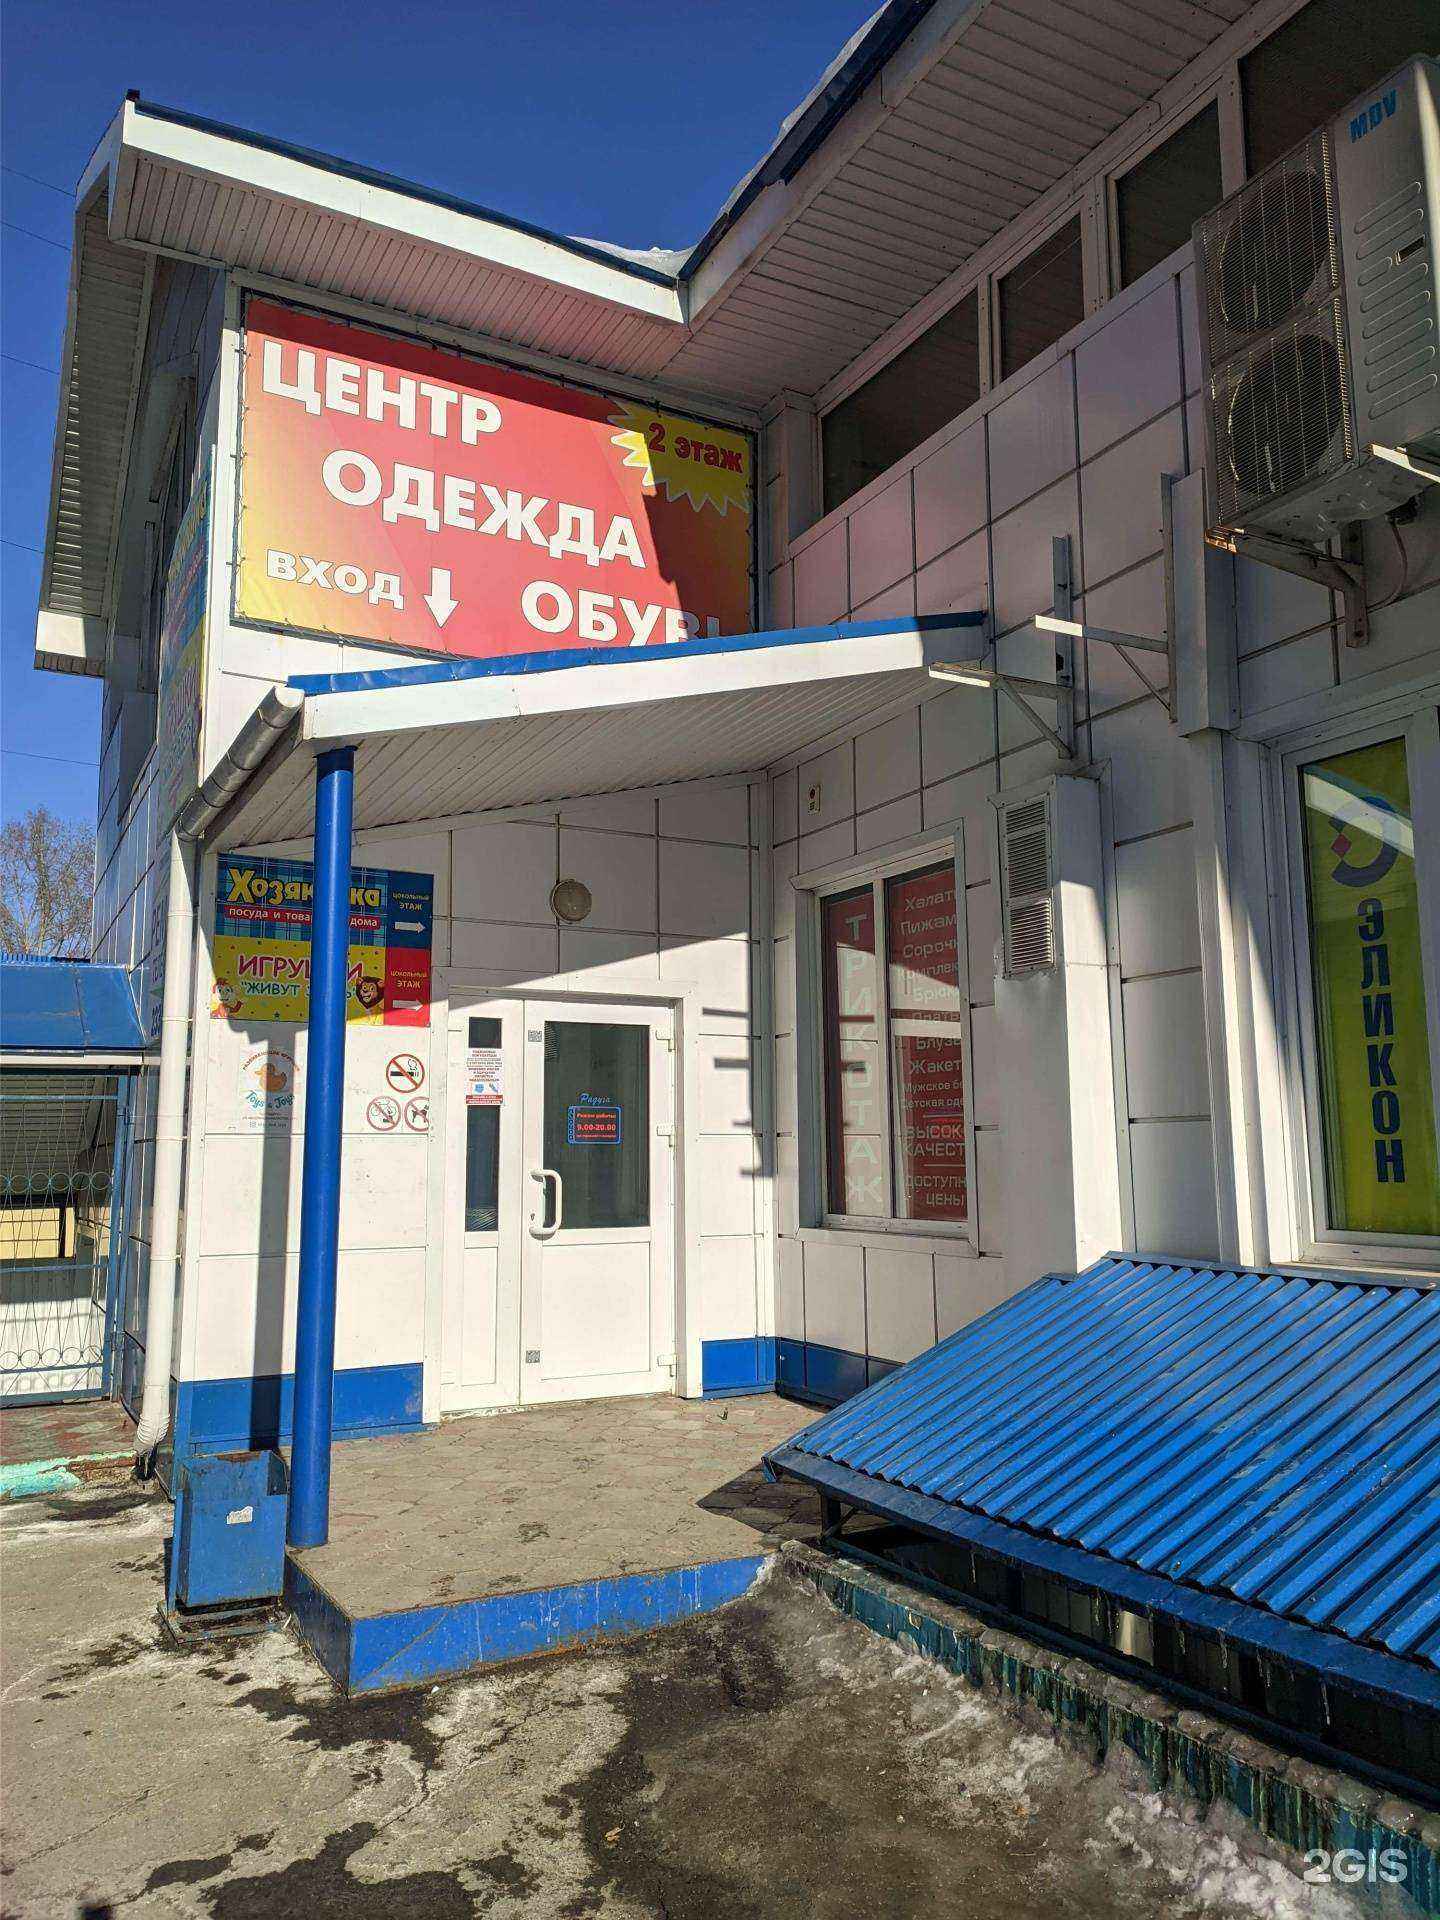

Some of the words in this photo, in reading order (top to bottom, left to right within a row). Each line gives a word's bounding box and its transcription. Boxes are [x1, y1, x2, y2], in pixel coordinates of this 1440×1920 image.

[1350, 89, 1397, 143] MDV
[262, 339, 502, 446] ЦЕНТР
[648, 422, 666, 452] 2
[673, 435, 744, 474] этаж
[321, 449, 646, 568] ОДЕЖДА
[226, 867, 381, 906] Хозяка
[400, 903, 422, 911] ЭТАЖ
[229, 908, 269, 920] посуда
[273, 911, 281, 919] и
[286, 912, 313, 922] това
[350, 917, 378, 928] дома
[238, 954, 364, 981] ИГРУИ
[397, 980, 420, 989] ЭТАЖ
[1357, 897, 1406, 1184] ЭЛИКОН
